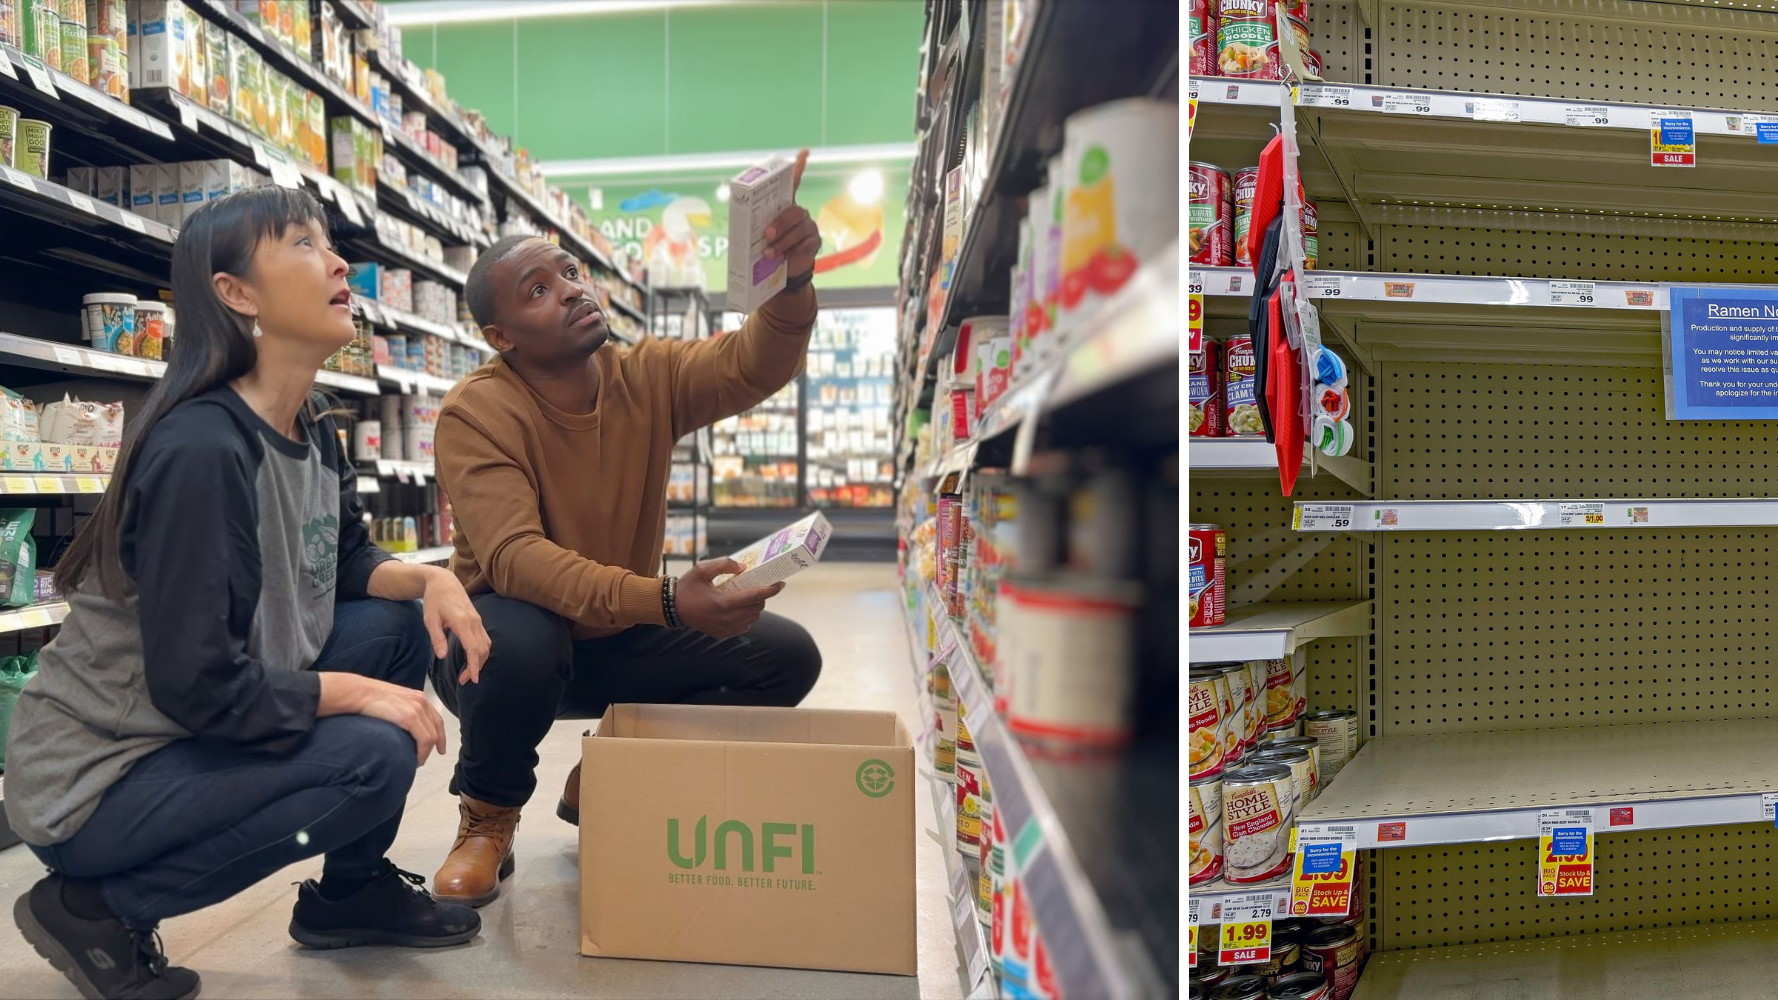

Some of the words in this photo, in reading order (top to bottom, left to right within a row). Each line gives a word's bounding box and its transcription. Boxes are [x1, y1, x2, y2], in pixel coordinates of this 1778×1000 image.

[1220, 0, 1264, 13] CHUNKY
[1225, 26, 1271, 35] CHICKEN
[1225, 33, 1271, 41] NOODLE
[1309, 63, 1319, 76] KY
[1664, 154, 1683, 163] SALE
[600, 217, 652, 240] AND
[1322, 288, 1341, 296] .99
[1577, 295, 1594, 303] .99
[1708, 303, 1760, 318] Ramen
[1691, 323, 1728, 332] Production
[1744, 325, 1765, 334] supply
[1730, 333, 1769, 342] significantly
[1693, 347, 1706, 355] You
[1708, 348, 1723, 356] may
[1724, 348, 1745, 356] notice
[1747, 348, 1769, 356] limited
[1747, 381, 1764, 389] your
[1228, 390, 1249, 402] CLAM
[1715, 390, 1749, 398] apologize
[1331, 519, 1350, 527] .59
[1195, 713, 1217, 727] Noodle
[1230, 786, 1259, 800] Campbell's
[1226, 790, 1269, 811] HOME
[1228, 799, 1271, 821] STYLE
[1232, 822, 1246, 832] New
[1246, 813, 1273, 828] England
[1232, 827, 1247, 838] Clam
[1247, 819, 1276, 834] Chowder
[667, 814, 815, 875] UNFI
[668, 873, 703, 885] BETTER
[706, 875, 734, 887] FOOD.
[737, 876, 773, 889] BETTER
[776, 878, 817, 891] FUTURE.
[1558, 876, 1591, 888] SAVE
[1332, 889, 1342, 897] Up
[1311, 895, 1348, 908] SAVE
[1251, 908, 1272, 919] 2.79
[1226, 923, 1268, 942] 1.99
[1233, 950, 1256, 960] SALE
